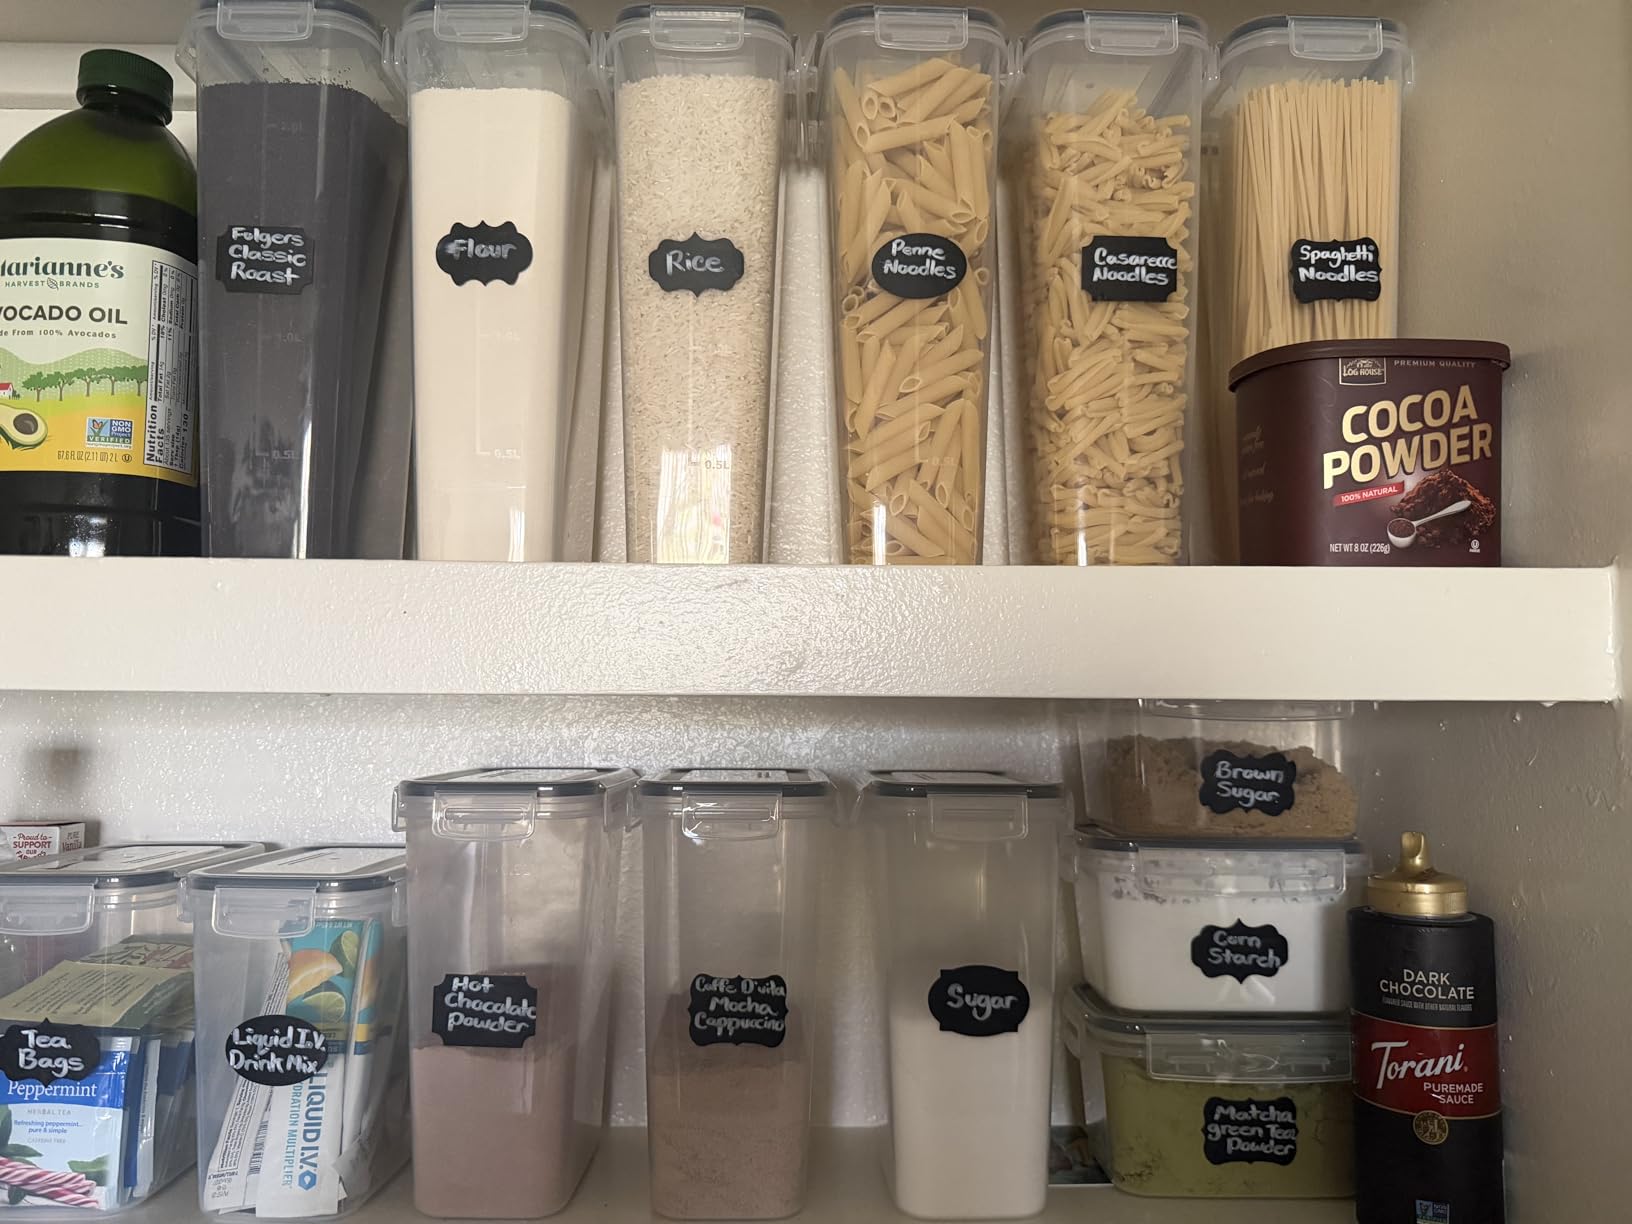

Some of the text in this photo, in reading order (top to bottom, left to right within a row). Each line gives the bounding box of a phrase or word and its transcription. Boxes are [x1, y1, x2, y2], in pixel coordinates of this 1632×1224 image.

[231, 227, 304, 249] Folgers
[228, 244, 307, 267] Classic
[446, 238, 517, 260] Flour
[891, 239, 946, 260] Penne
[1300, 244, 1375, 268] Spaghetti
[230, 261, 300, 285] Roast
[666, 250, 725, 276] Rice
[883, 258, 957, 279] Noodles
[1298, 264, 1379, 282] Noodles
[5, 280, 100, 289] HARVEST BRANDS
[1093, 266, 1169, 285] Noodles
[0, 305, 128, 325] OCADO OIL
[68, 330, 117, 339] Avocados
[1343, 364, 1382, 377] LOG HOUSE
[1439, 360, 1476, 368] QUALITY
[1342, 384, 1478, 443] COCOA
[89, 436, 131, 444] VERIFIED
[146, 405, 158, 462] Nutrition
[155, 428, 165, 464] Facts
[1323, 423, 1493, 489] POWDER
[705, 459, 730, 470] 0.5L
[1341, 485, 1398, 503] 100% NATURAL
[1329, 543, 1390, 554] NET WT 8 OZ (226g)
[1214, 760, 1284, 783] Brown
[1213, 930, 1261, 949] Corn
[1208, 947, 1281, 968] Starch
[452, 976, 494, 993] Hot
[1403, 968, 1450, 985] DARK
[1379, 979, 1475, 1000] CHOCOLATE
[709, 996, 778, 1016] Mocha
[947, 983, 1019, 1020] Sugar
[232, 1025, 294, 1056] Liquid
[18, 1048, 85, 1078] Bags
[229, 1049, 318, 1074] Drink Mix
[1371, 1041, 1465, 1089] Torani
[8, 1080, 97, 1100] Peppermint
[1423, 1082, 1484, 1093] PUREMADE
[288, 1081, 304, 1127] DRATION
[1438, 1094, 1474, 1104] SAUCE
[299, 1071, 328, 1170] LIQUID I.V.
[1213, 1104, 1296, 1123] Matcha
[1207, 1123, 1296, 1140] green Tea
